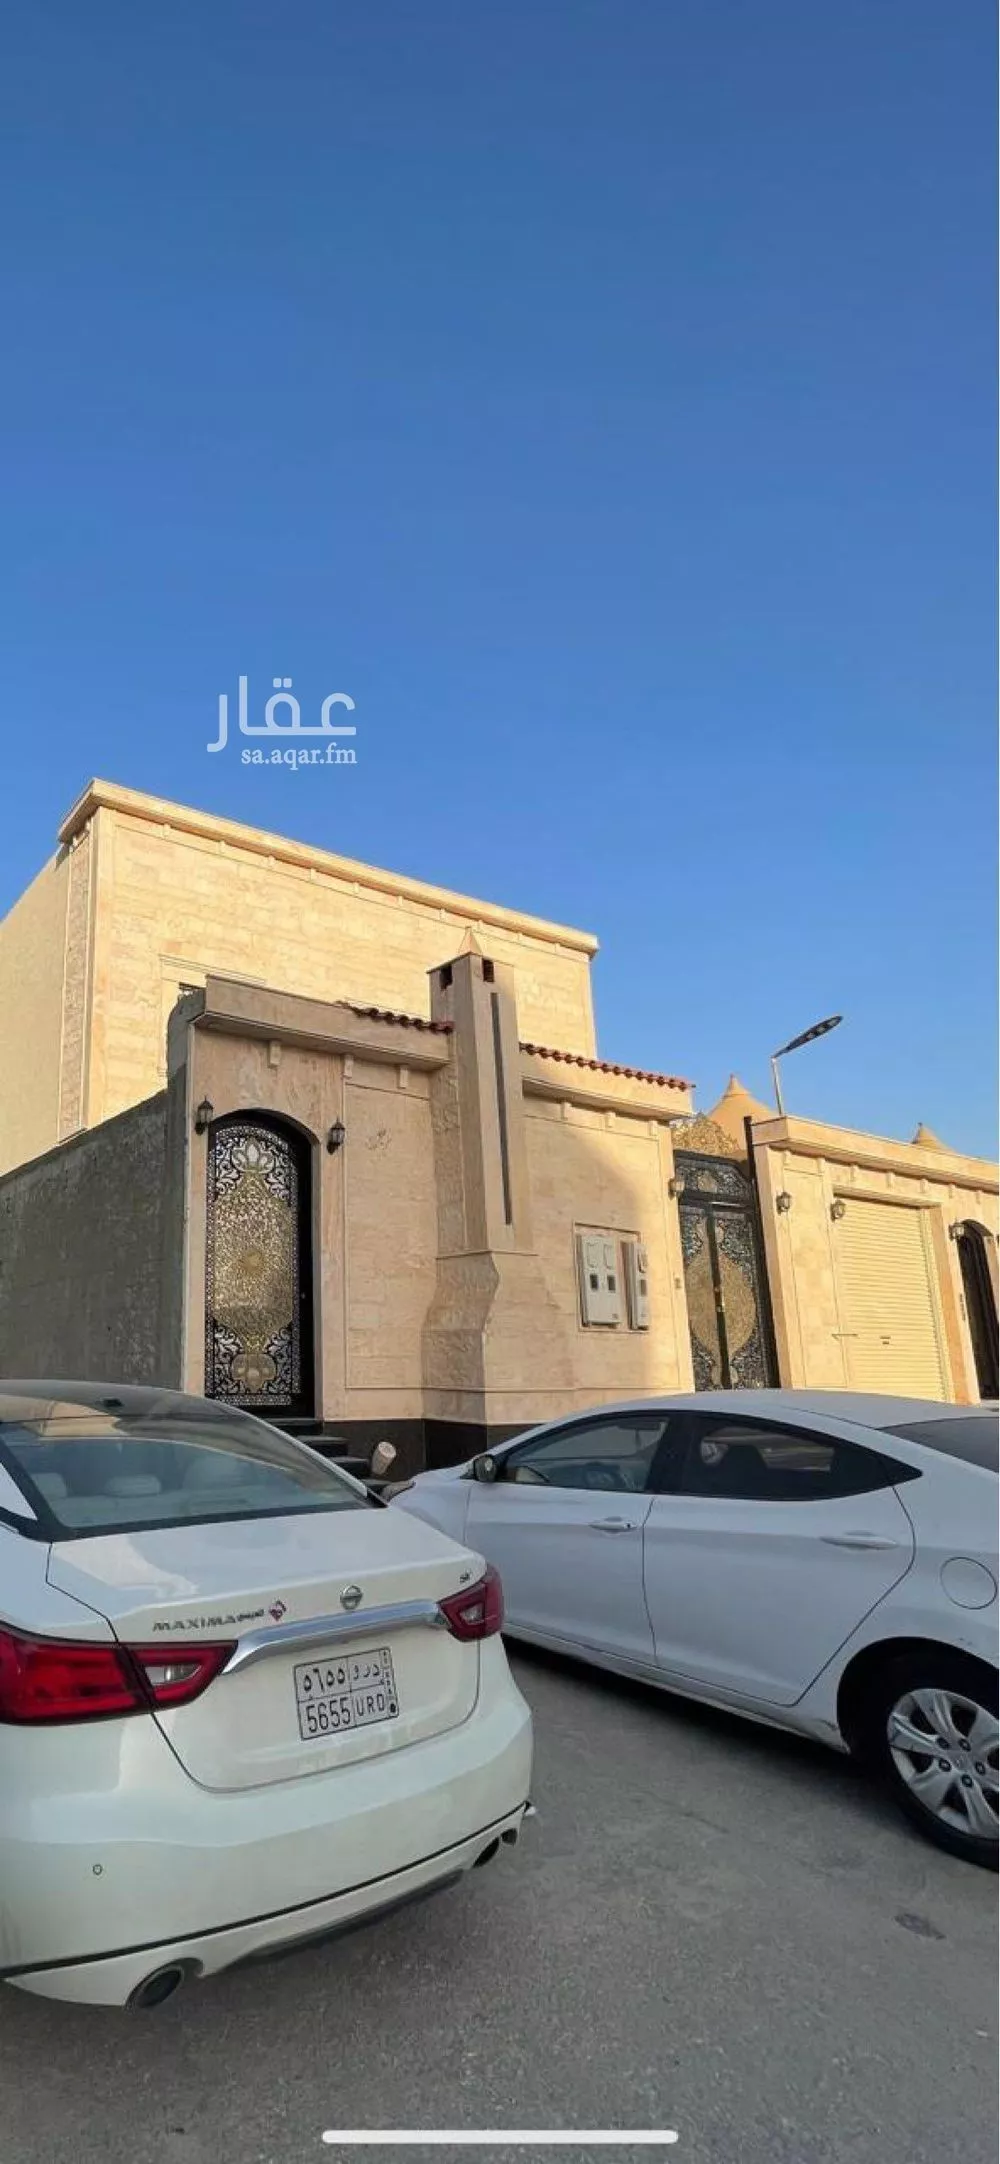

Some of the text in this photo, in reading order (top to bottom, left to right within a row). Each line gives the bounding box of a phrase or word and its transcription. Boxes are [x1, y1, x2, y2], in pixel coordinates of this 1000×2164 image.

[152, 1614, 236, 1632] MAXIMA
[306, 1693, 385, 1732] 5655 URD
